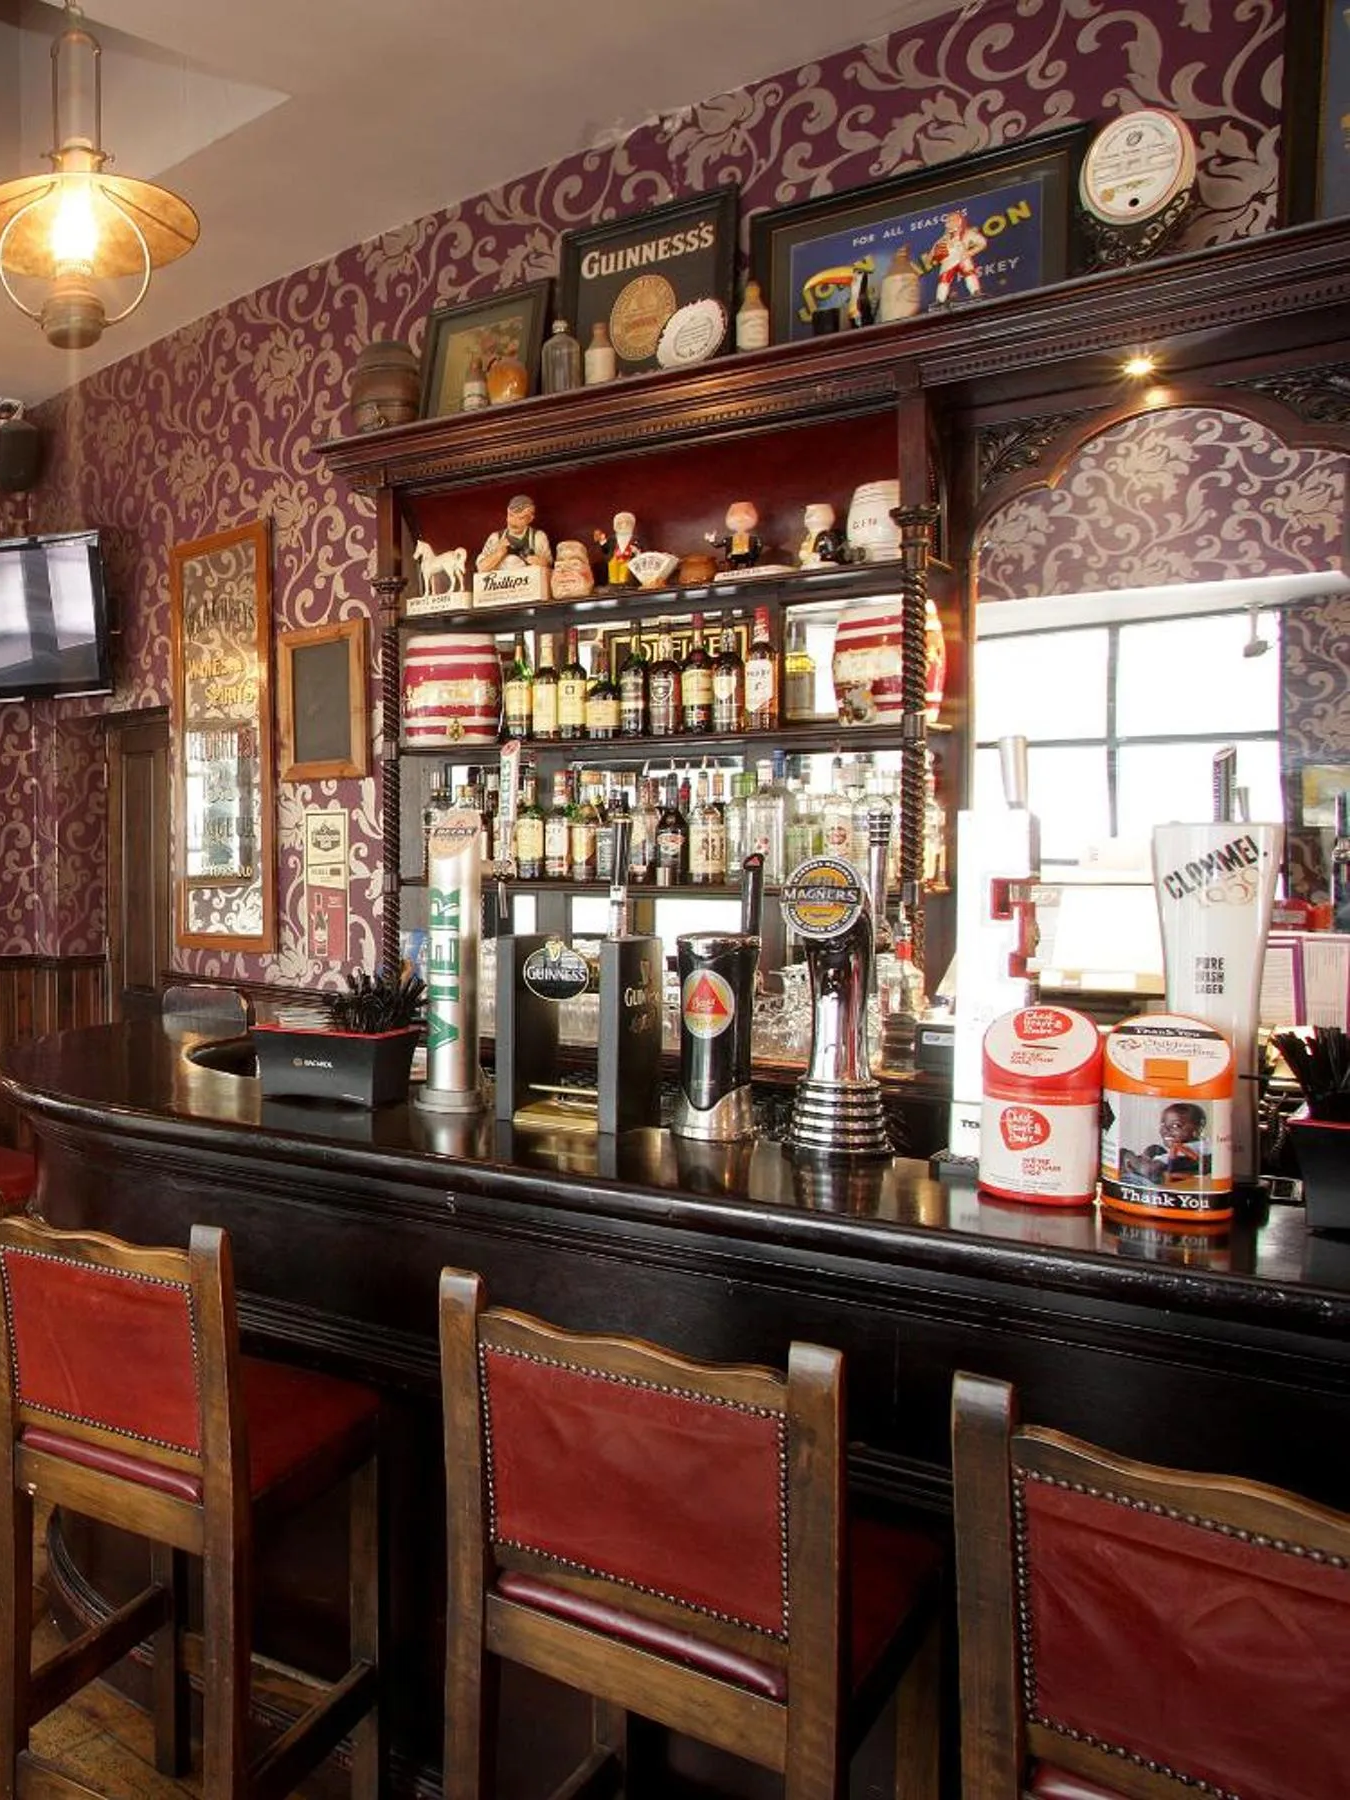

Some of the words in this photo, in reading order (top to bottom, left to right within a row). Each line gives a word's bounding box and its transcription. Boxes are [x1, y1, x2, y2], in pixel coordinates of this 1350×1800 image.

[852, 234, 876, 248] FOR
[883, 226, 905, 239] ALL
[482, 573, 530, 592] Phillips
[782, 886, 858, 903] MAGNERS
[427, 887, 461, 1051] VIER
[526, 966, 586, 982] GUINNESS
[1120, 1187, 1175, 1207] Thank
[1177, 1194, 1210, 1209] You
